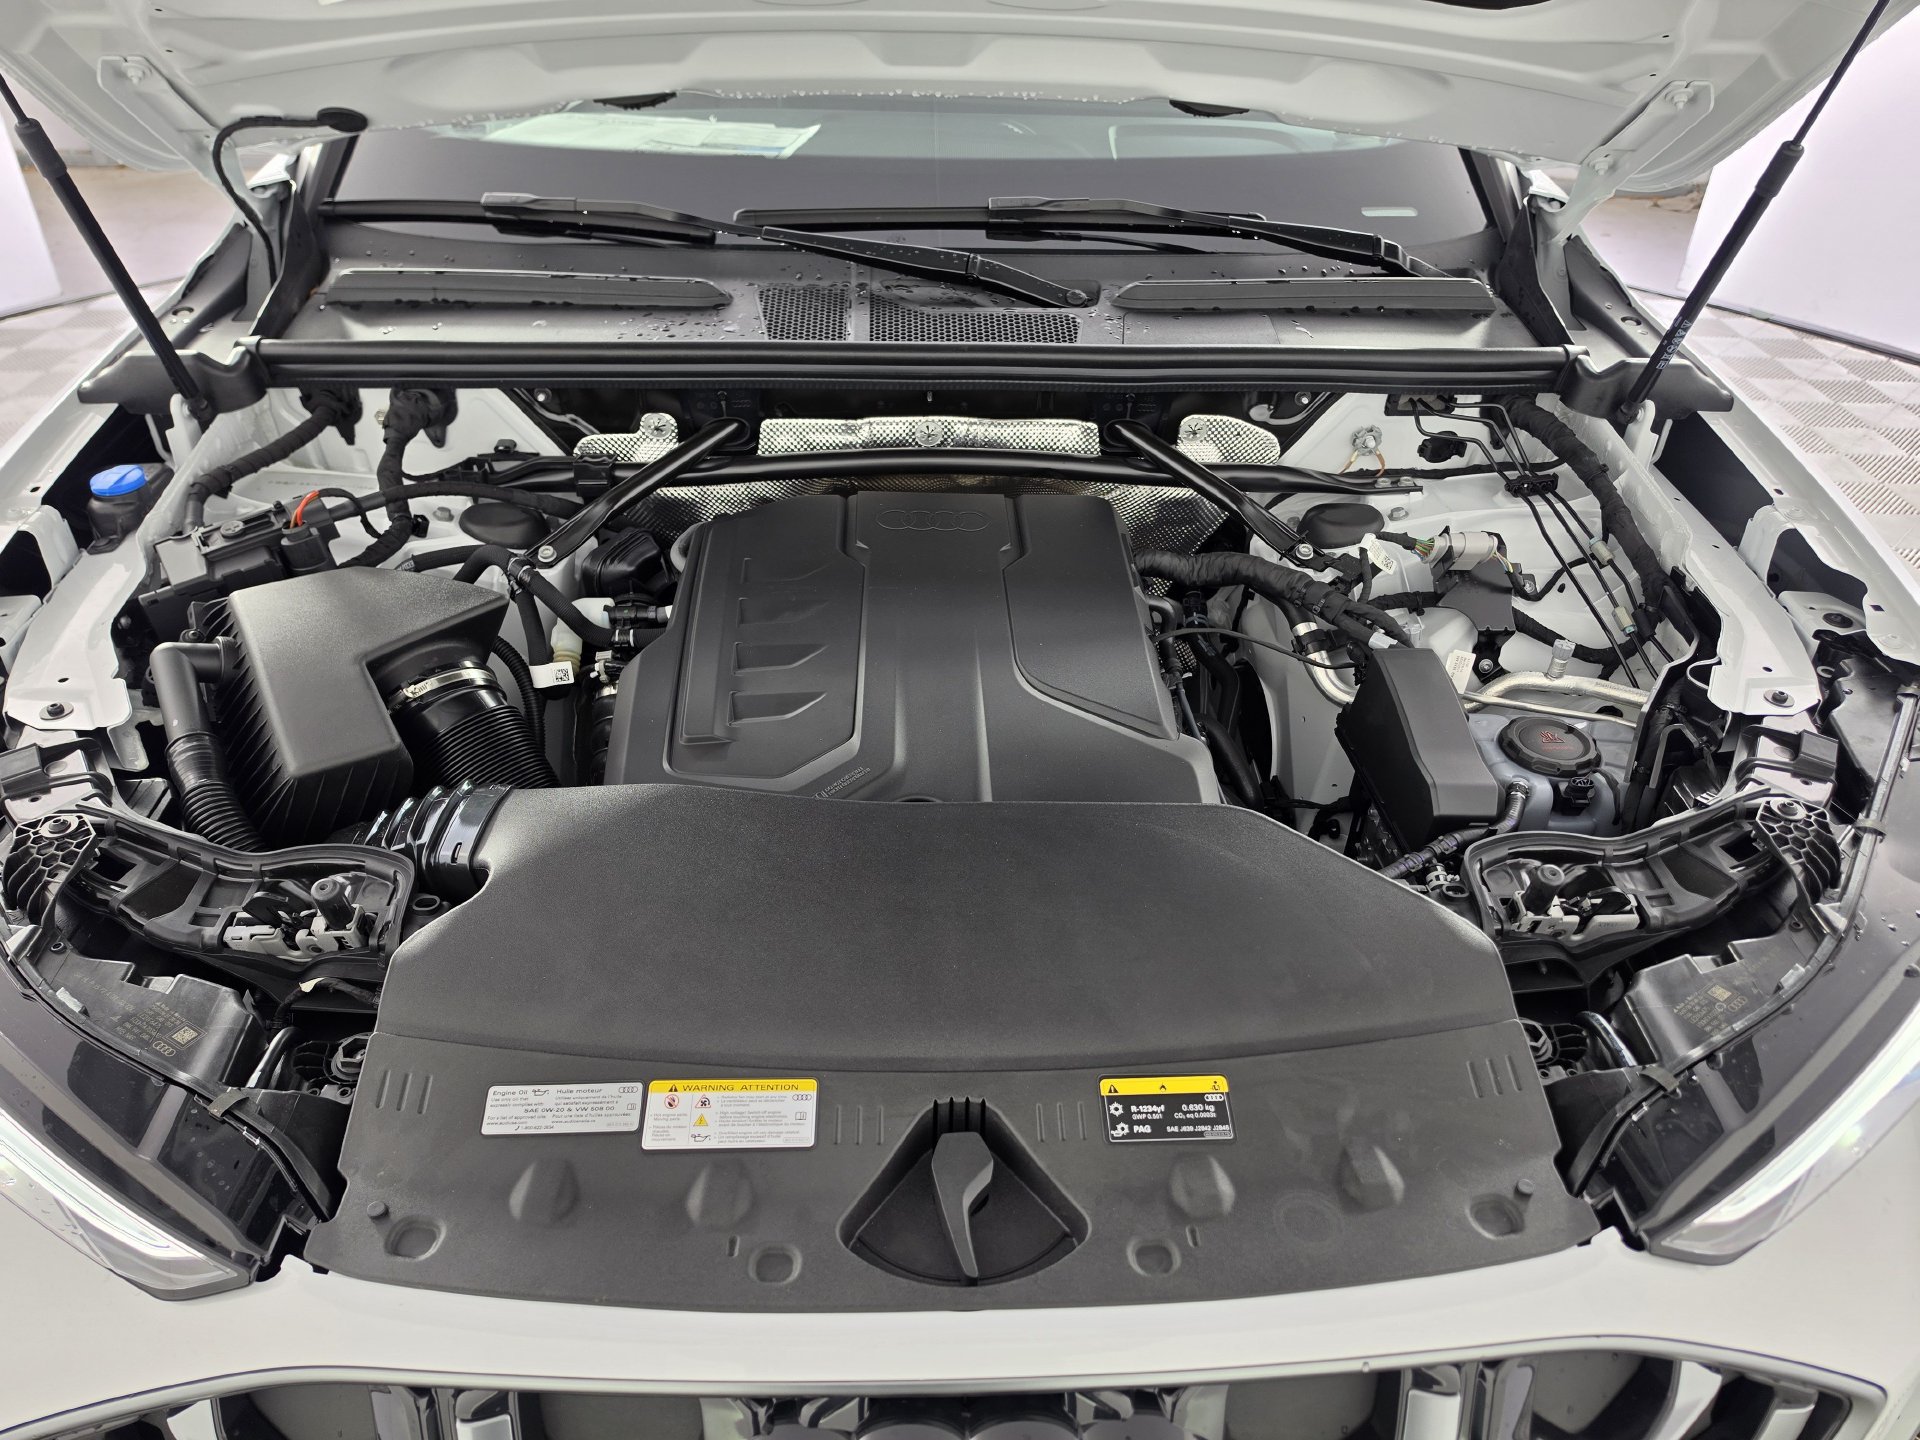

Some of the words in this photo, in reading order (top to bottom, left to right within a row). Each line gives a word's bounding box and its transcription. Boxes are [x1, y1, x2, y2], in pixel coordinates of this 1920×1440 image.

[682, 1084, 734, 1092] WARNING
[740, 1083, 799, 1091] ATTENTION
[1130, 1104, 1165, 1113] R-1234yf
[1205, 1103, 1215, 1112] kg
[1133, 1125, 1152, 1133] PAG
